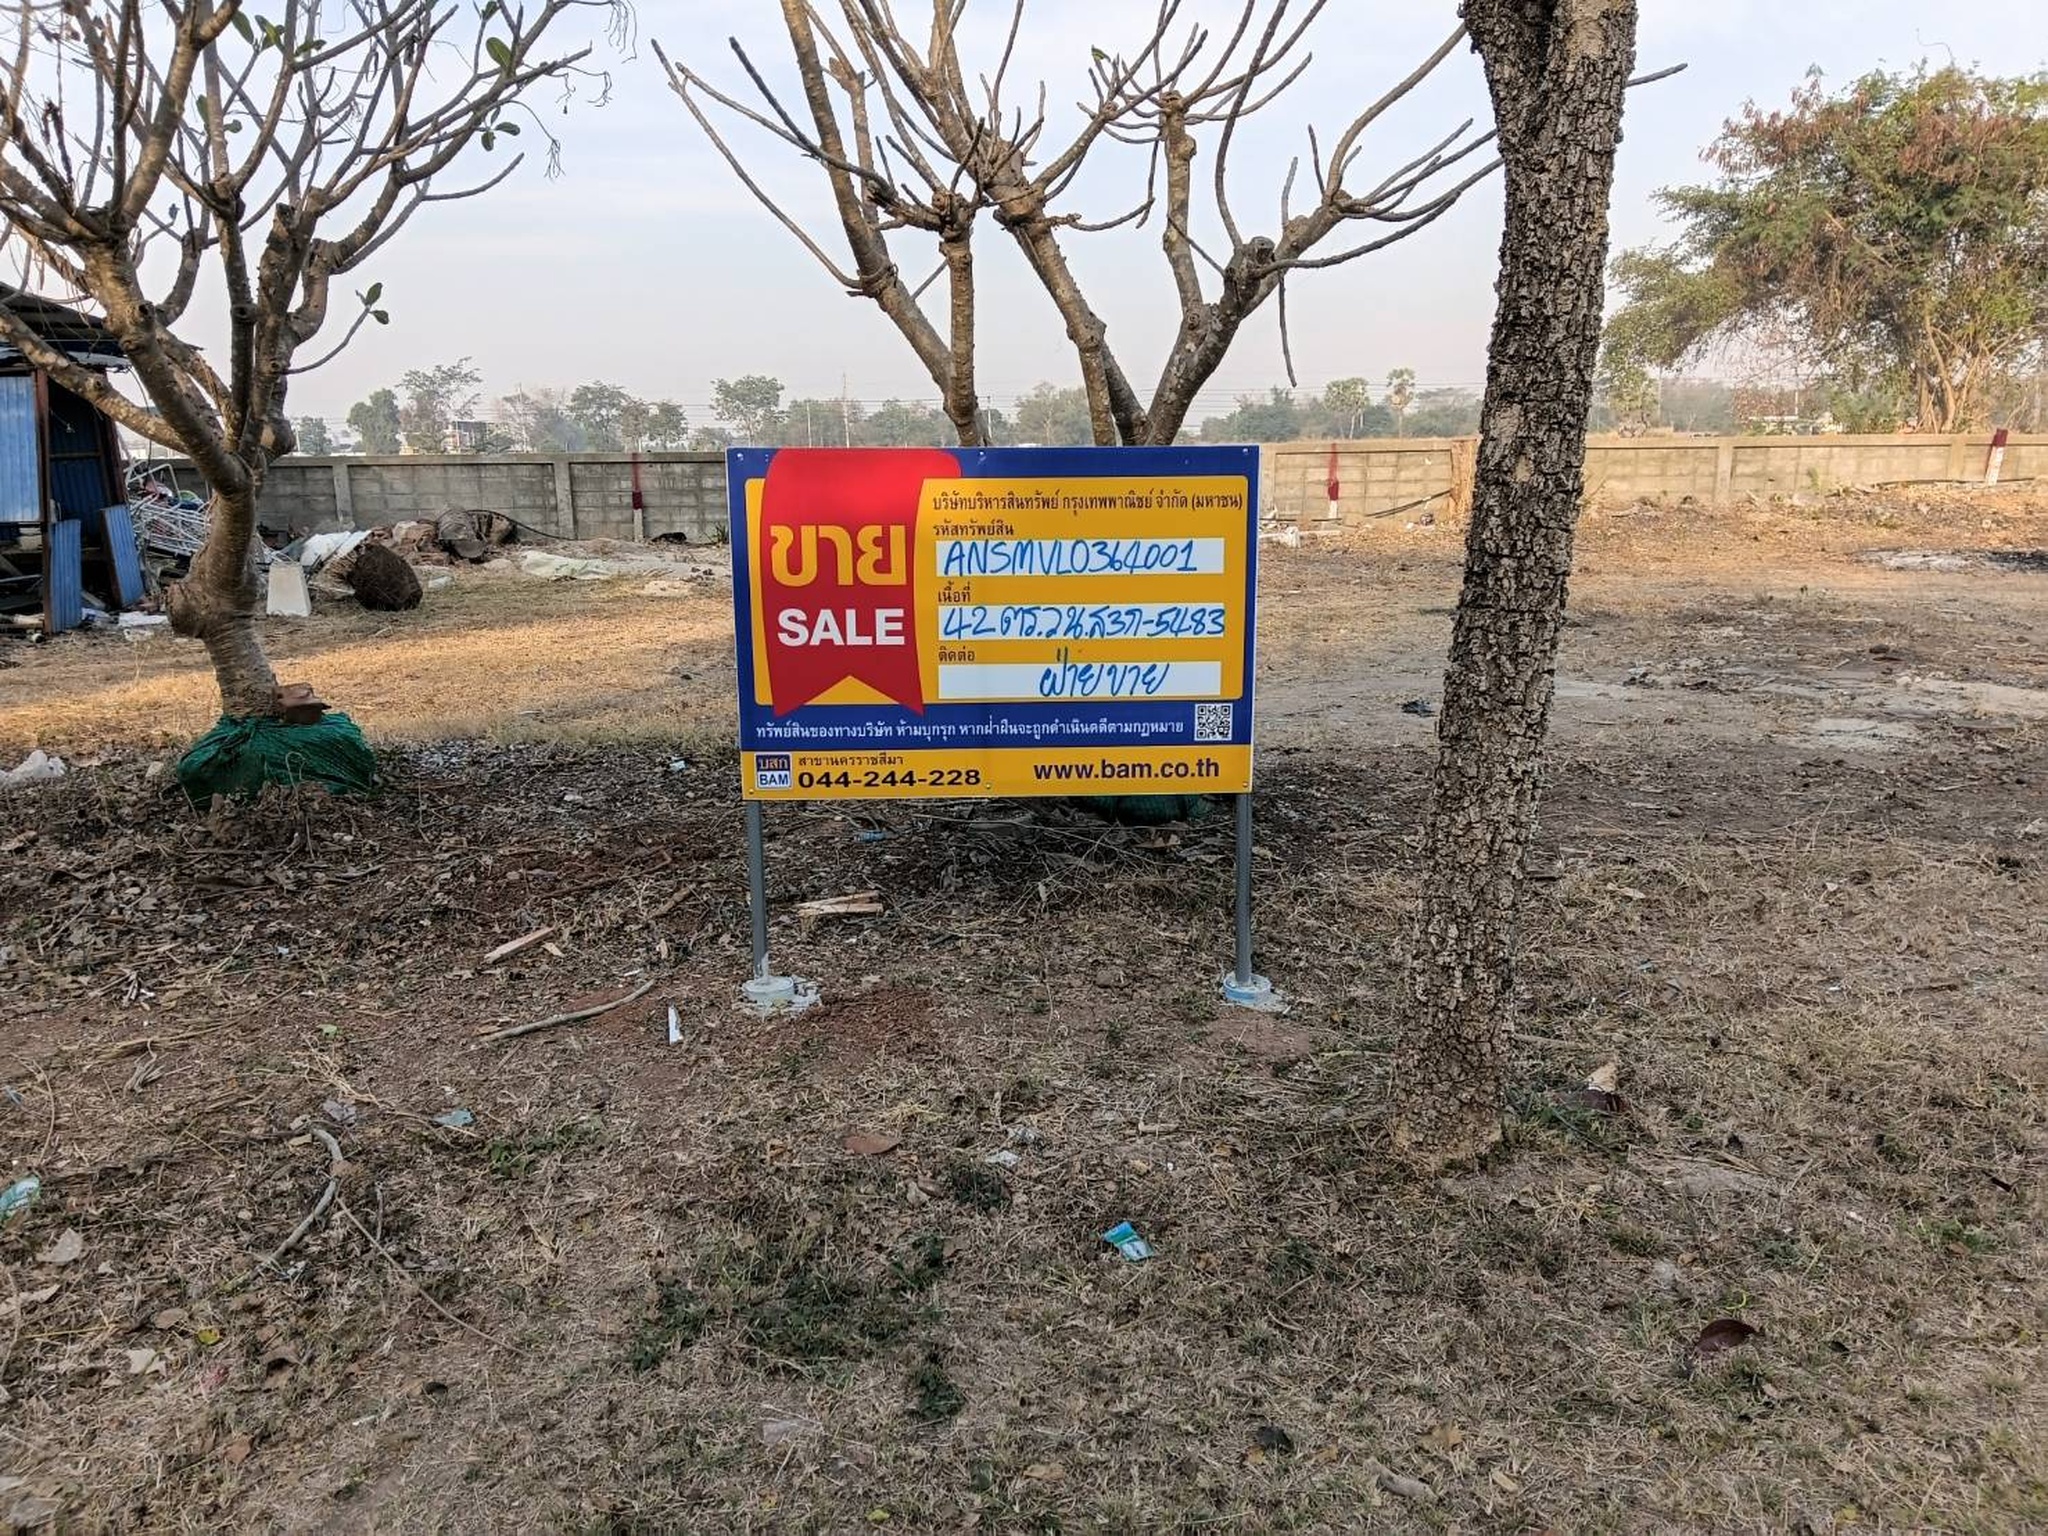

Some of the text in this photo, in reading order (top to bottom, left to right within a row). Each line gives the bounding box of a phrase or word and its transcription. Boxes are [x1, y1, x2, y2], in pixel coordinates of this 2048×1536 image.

[932, 488, 1243, 516] บริษัทบริหารสินทรัพย์ กรุงเทพพาณิชย์ จำกัด (มหาชน)
[932, 519, 1015, 537] รหัสทรัพย์สิน
[769, 524, 907, 587] ขาย
[938, 581, 972, 603] เนื้อที่
[777, 608, 906, 647] SALE
[938, 646, 976, 662] ติดต่อ
[756, 720, 893, 739] ทรัพย์สินของทางบริษัท
[896, 718, 956, 742] ห้ามบุกรุก
[799, 752, 904, 766] สาขานครราชสีมา
[1034, 758, 1220, 779] www.bam.co.th
[759, 774, 789, 785] BAM
[798, 769, 981, 788] 044-244-228
